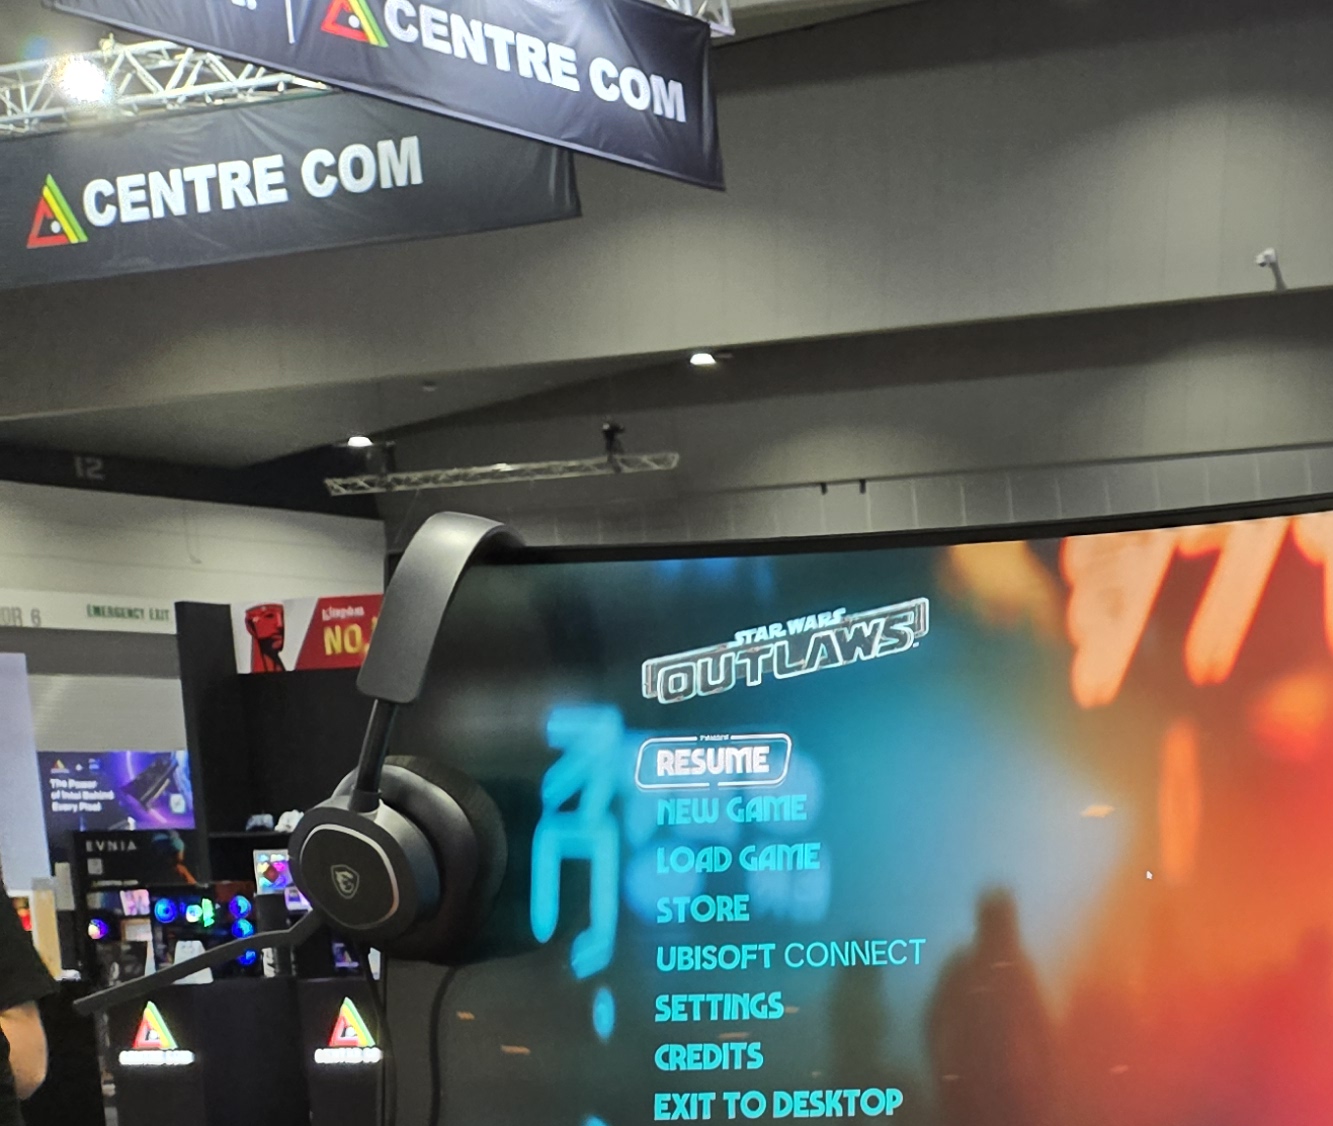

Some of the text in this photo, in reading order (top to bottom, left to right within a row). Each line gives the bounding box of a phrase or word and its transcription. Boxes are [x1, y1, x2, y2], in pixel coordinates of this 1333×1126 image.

[384, 0, 687, 123] CENTRE COM
[82, 136, 424, 227] CENTRE COM
[86, 604, 170, 622] EMERGENCY EXIT
[733, 607, 847, 648] STAR WARS
[657, 611, 916, 703] OUTLAWS
[657, 746, 770, 776] RESUME
[657, 794, 807, 825] NEW GAME
[657, 843, 821, 874] LOAD GAME
[657, 895, 750, 924] STORE
[657, 939, 926, 971] UBISOFT CONNECT
[655, 992, 784, 1022] SETTINGS
[655, 1042, 763, 1071] CREDITS
[654, 1088, 904, 1120] EXIT TO DESKTOP
